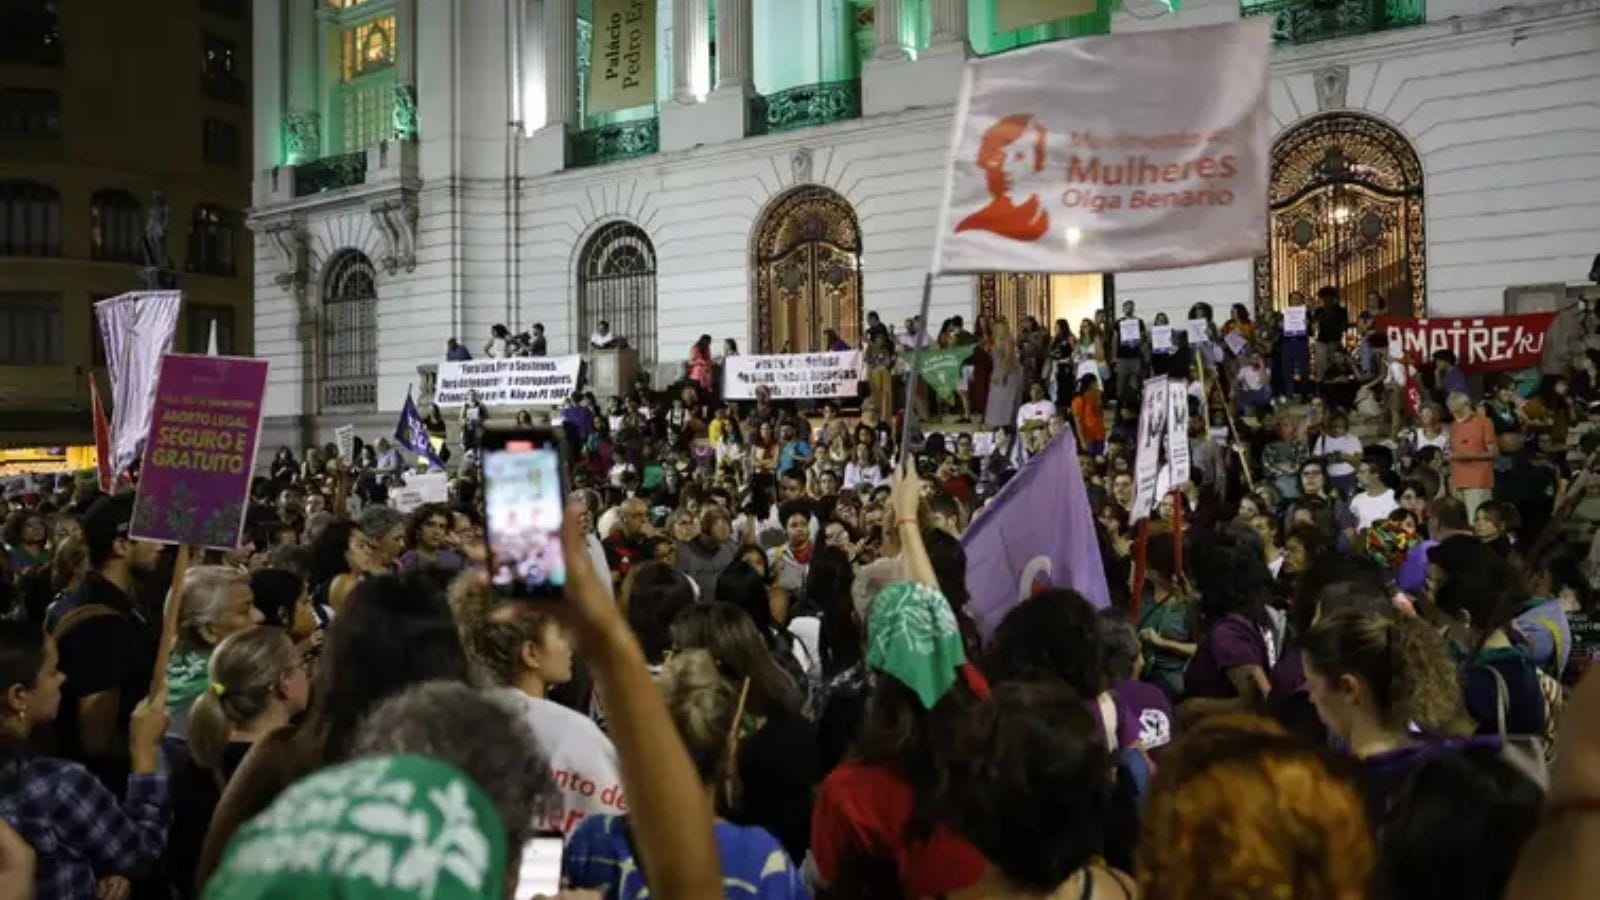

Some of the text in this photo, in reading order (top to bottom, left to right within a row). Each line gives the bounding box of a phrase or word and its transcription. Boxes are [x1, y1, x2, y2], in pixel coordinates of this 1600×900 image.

[605, 12, 621, 80] Palácio
[622, 28, 641, 90] Pedro
[1066, 154, 1237, 185] Mulheres
[1061, 185, 1234, 213] Olga Benario
[163, 410, 249, 428] ABORTO LEGAL
[158, 427, 247, 452] SEGURO E
[151, 447, 245, 474] GRATUITO
